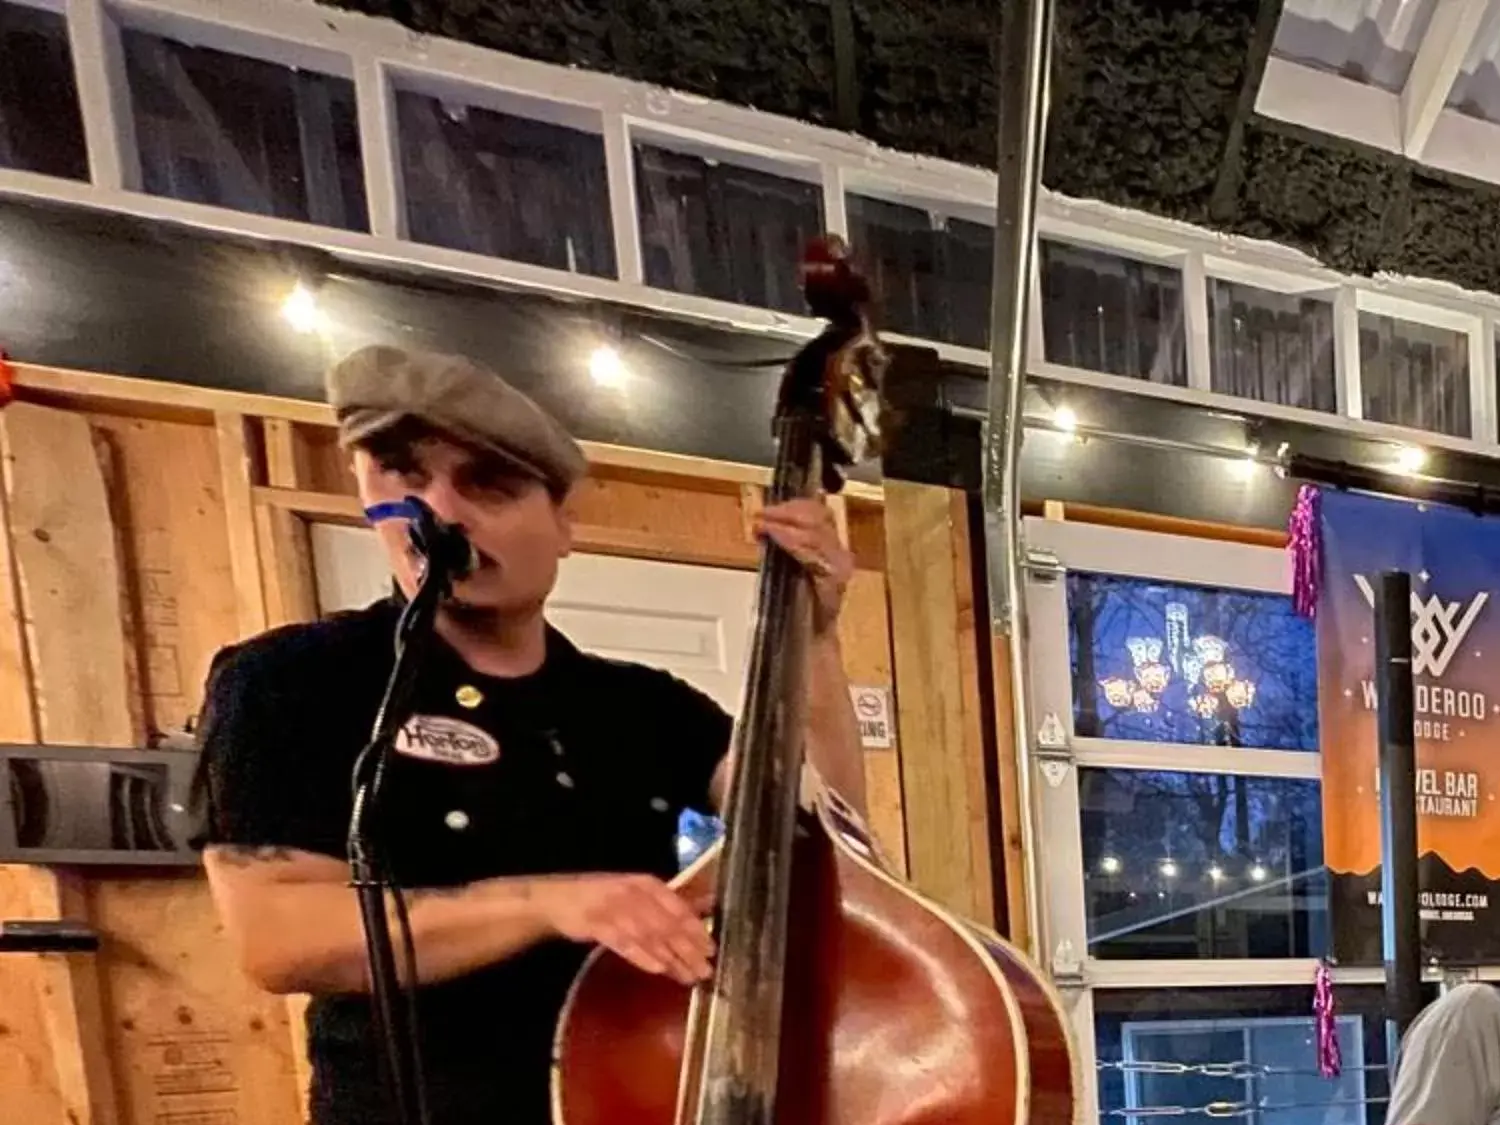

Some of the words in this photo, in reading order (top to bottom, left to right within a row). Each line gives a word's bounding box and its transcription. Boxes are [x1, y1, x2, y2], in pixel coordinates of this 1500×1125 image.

[1361, 679, 1486, 720] WDEROO
[1413, 719, 1451, 741] ODGE
[1444, 771, 1478, 798] BAR
